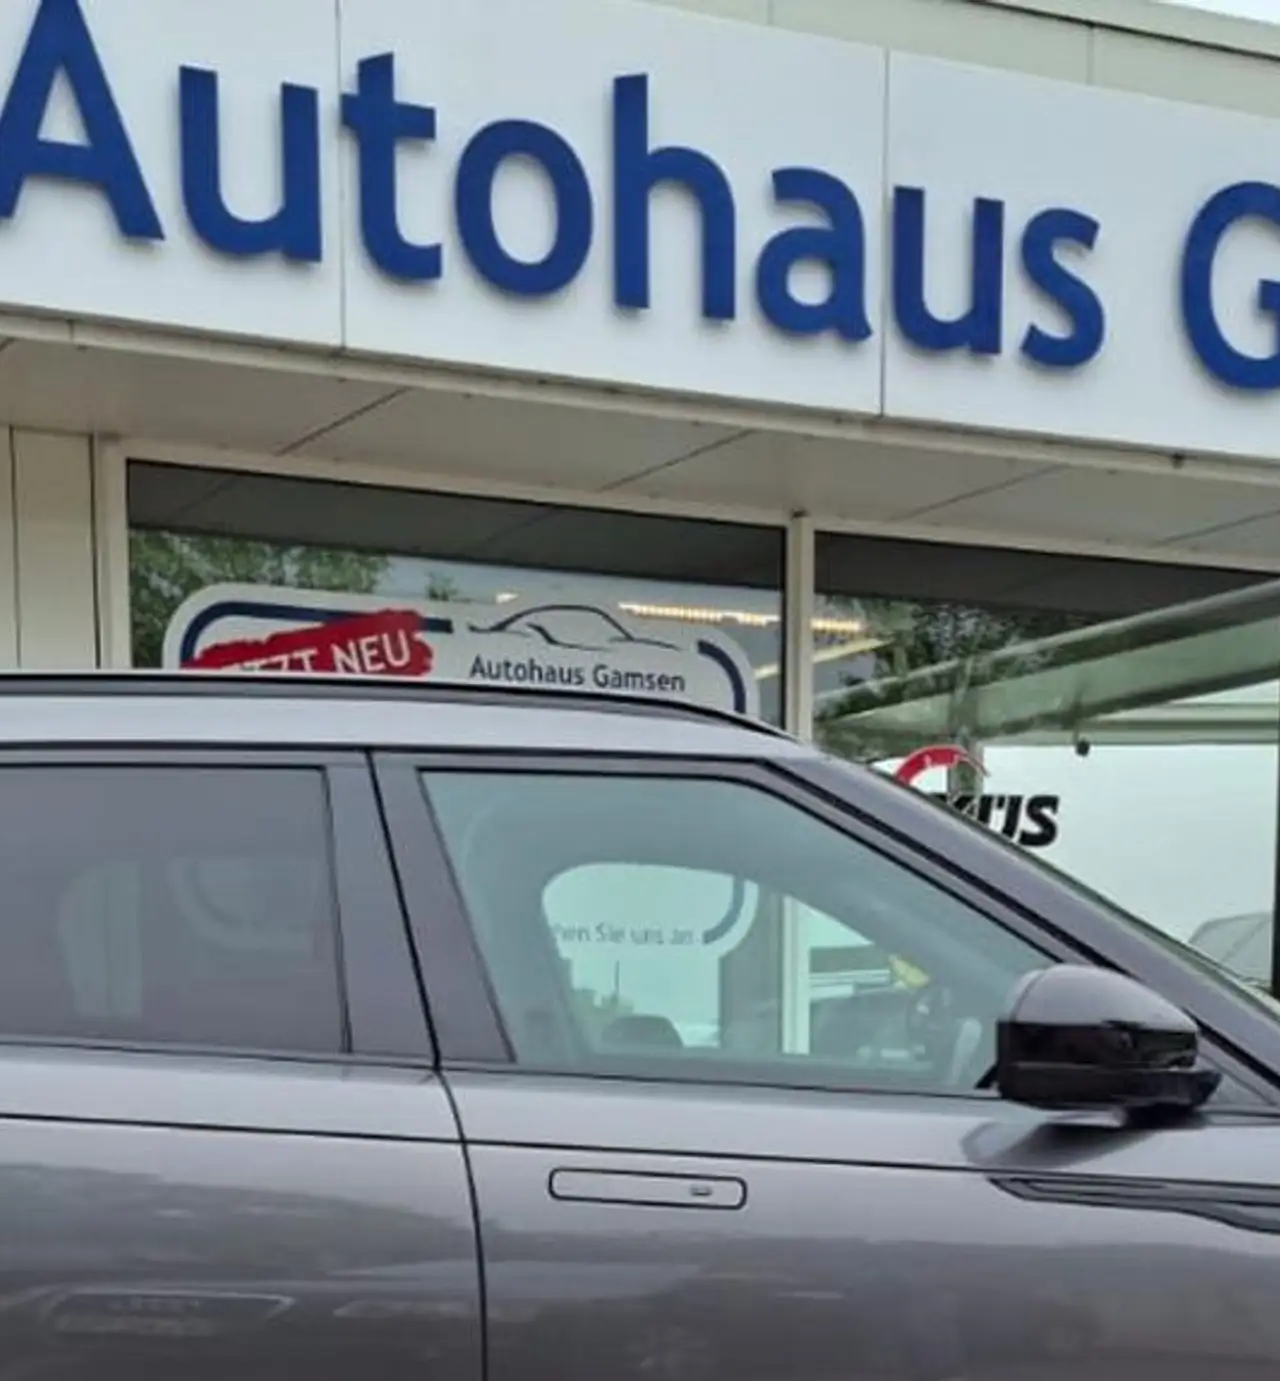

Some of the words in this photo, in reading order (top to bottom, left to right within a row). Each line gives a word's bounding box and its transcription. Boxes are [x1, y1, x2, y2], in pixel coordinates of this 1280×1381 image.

[330, 628, 411, 674] NEU
[469, 653, 585, 686] Autohaus
[592, 663, 685, 692] Gamsen
